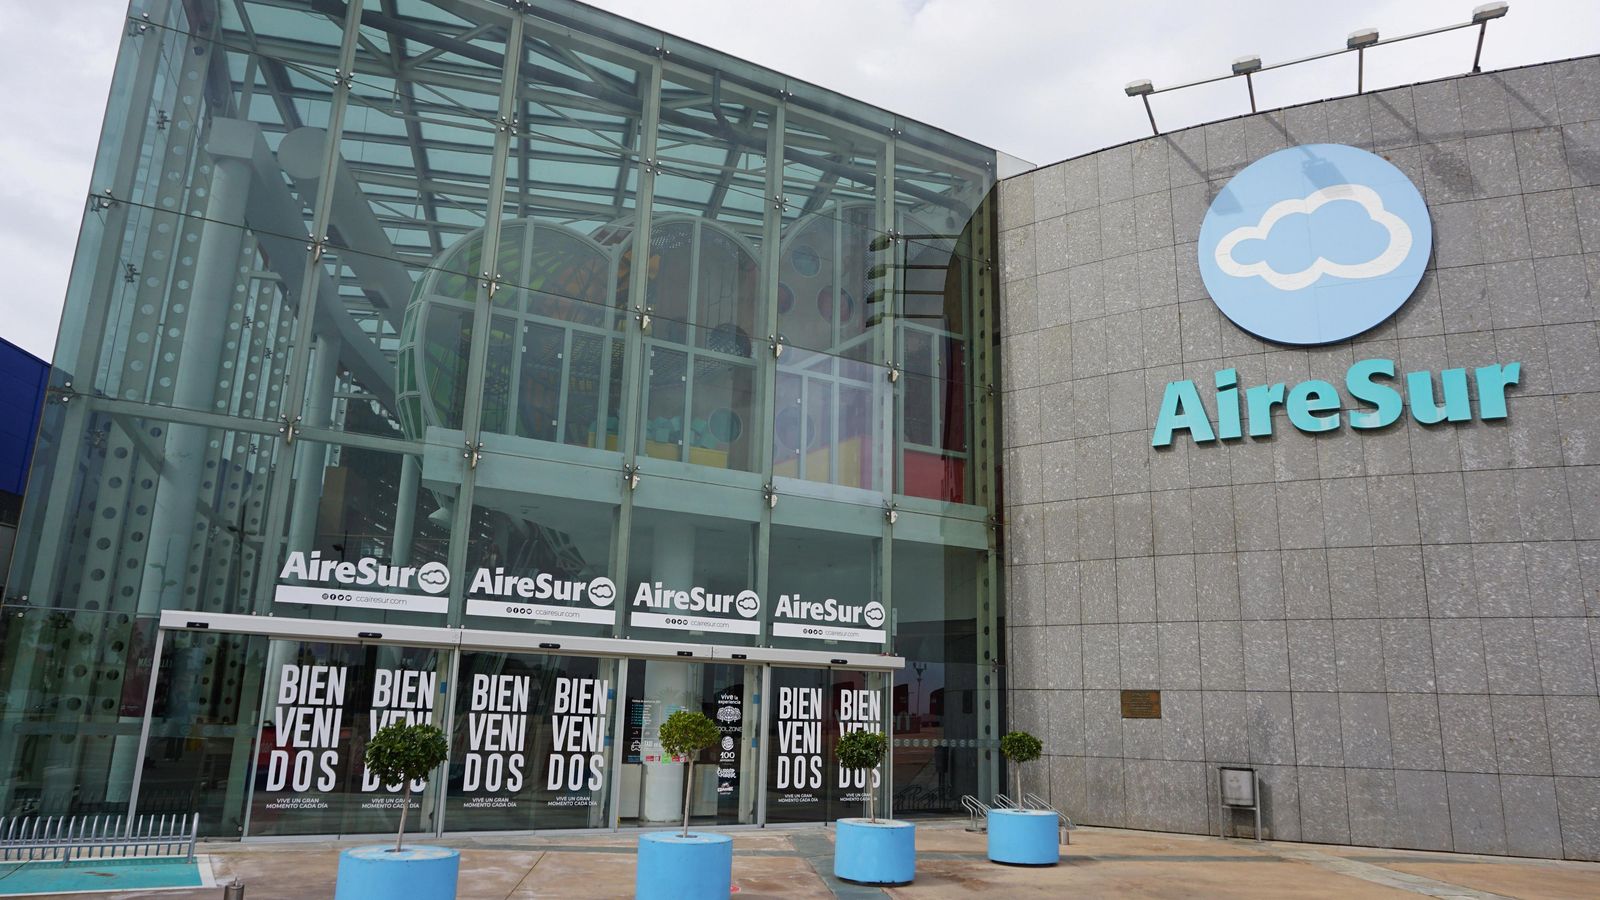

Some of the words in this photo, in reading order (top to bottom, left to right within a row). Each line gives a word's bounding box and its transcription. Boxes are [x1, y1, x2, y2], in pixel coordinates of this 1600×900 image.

[1152, 358, 1522, 448] AireSur
[280, 550, 416, 588] AireSur
[470, 567, 587, 602] AireSur
[355, 595, 408, 606] ccairesur.com
[535, 608, 580, 619] ccairesur.com
[632, 581, 734, 613] AireSur
[775, 594, 863, 623] AireSur
[278, 664, 347, 706] BIEN
[372, 668, 436, 709] BIEN
[471, 673, 529, 713] BIEN
[553, 677, 609, 715] BIEN
[779, 687, 822, 720] BIEN
[840, 689, 881, 721] BIEN
[275, 706, 341, 748] VENI
[468, 713, 527, 752] VENI
[551, 715, 605, 753] VENI
[778, 721, 821, 754] VENI
[266, 749, 339, 792] DOS
[462, 753, 525, 792] DOS
[547, 753, 604, 792] DOS
[776, 755, 822, 789] DOS
